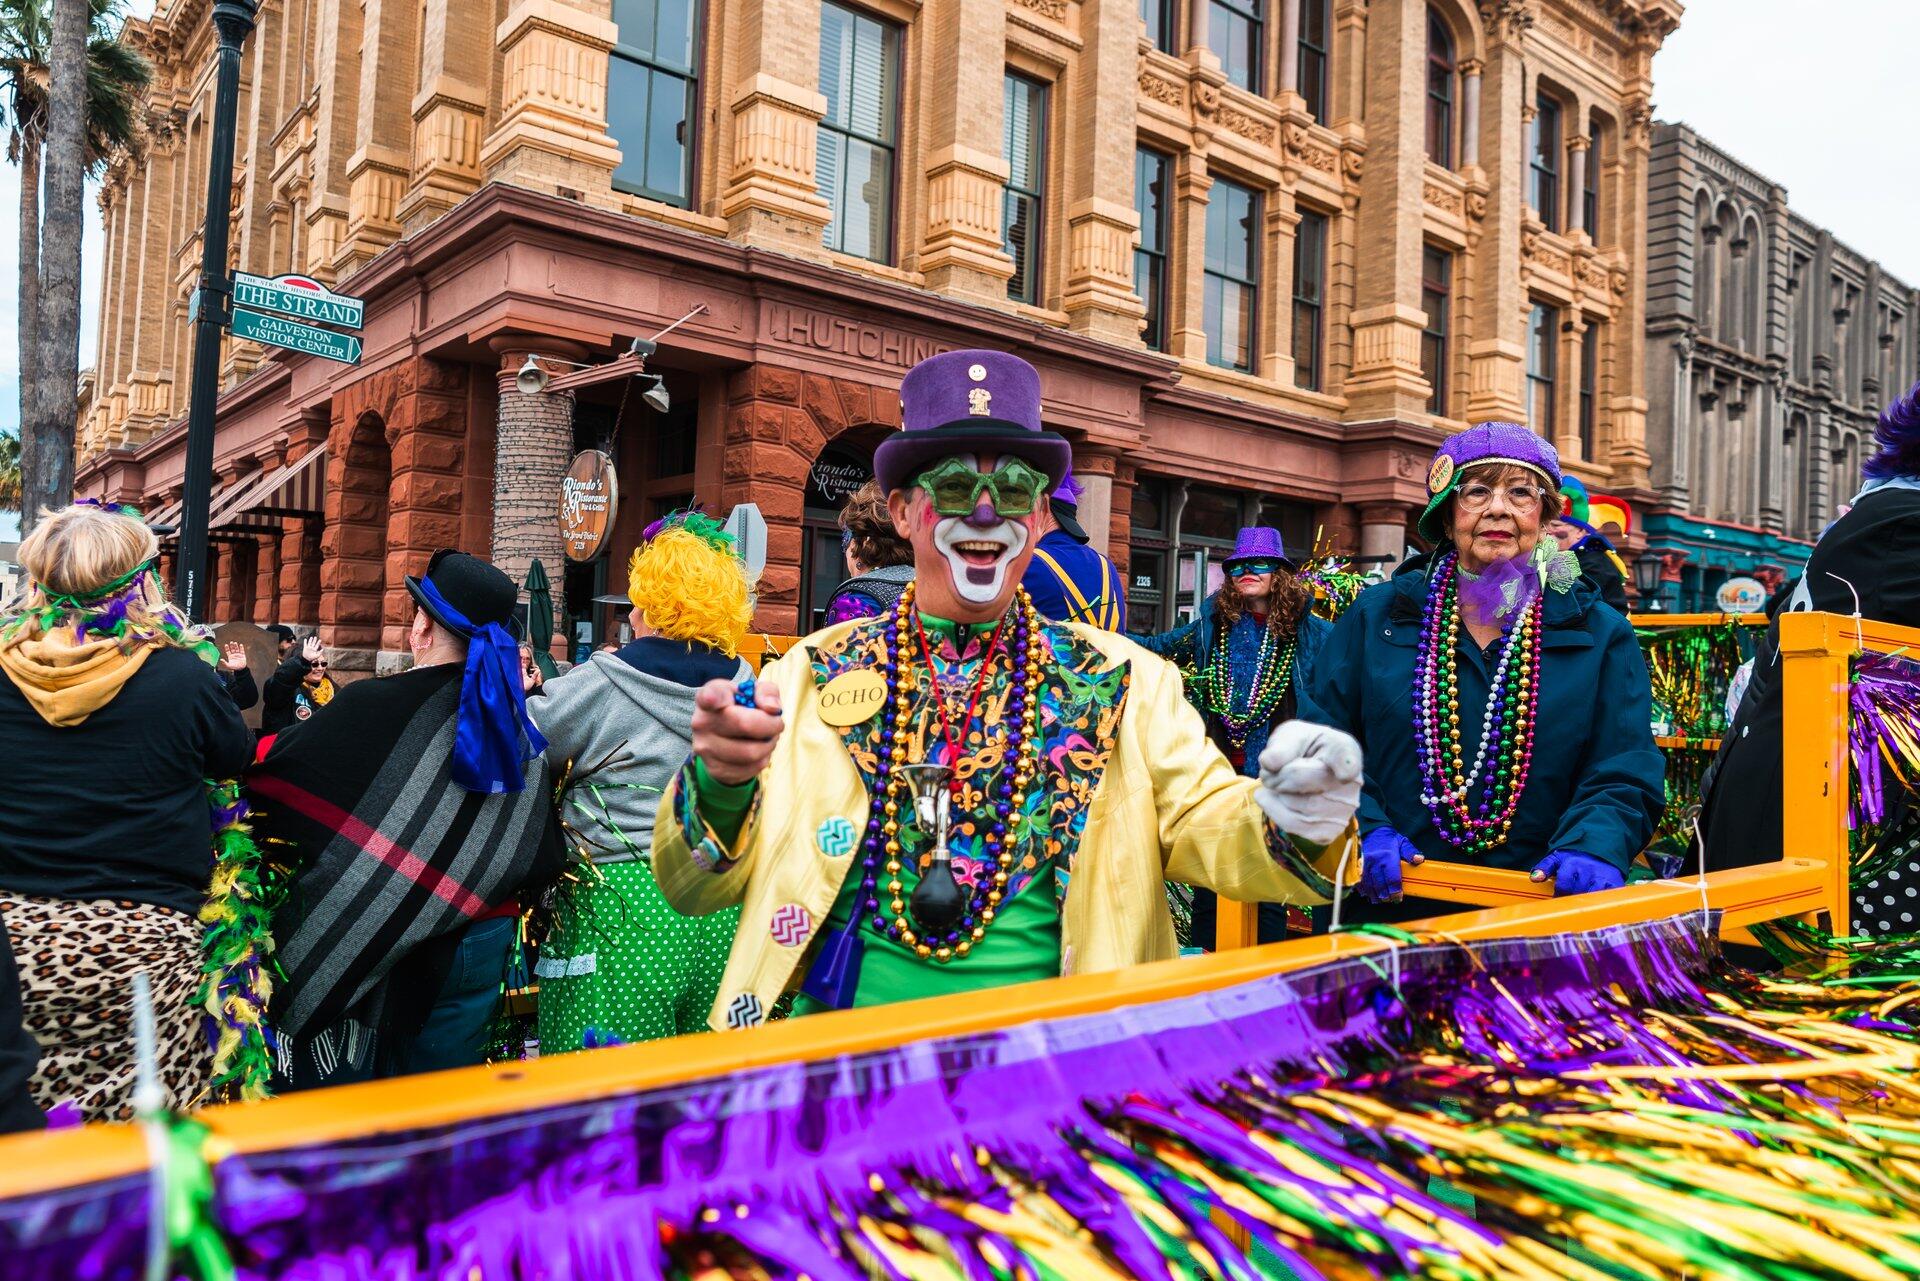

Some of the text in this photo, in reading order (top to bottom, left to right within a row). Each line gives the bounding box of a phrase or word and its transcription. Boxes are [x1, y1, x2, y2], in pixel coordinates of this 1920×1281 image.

[260, 280, 288, 290] STRAND
[237, 284, 360, 325] THE STRAND
[246, 325, 345, 358] VISITOR CENTER
[259, 318, 332, 344] GALVESTON
[787, 309, 950, 368] HUTCHIN
[1430, 457, 1448, 480] MARDI
[563, 477, 603, 506] Riondo's
[817, 473, 866, 501] Ristoran
[1136, 575, 1151, 587] 2326
[821, 686, 883, 708] OCHO
